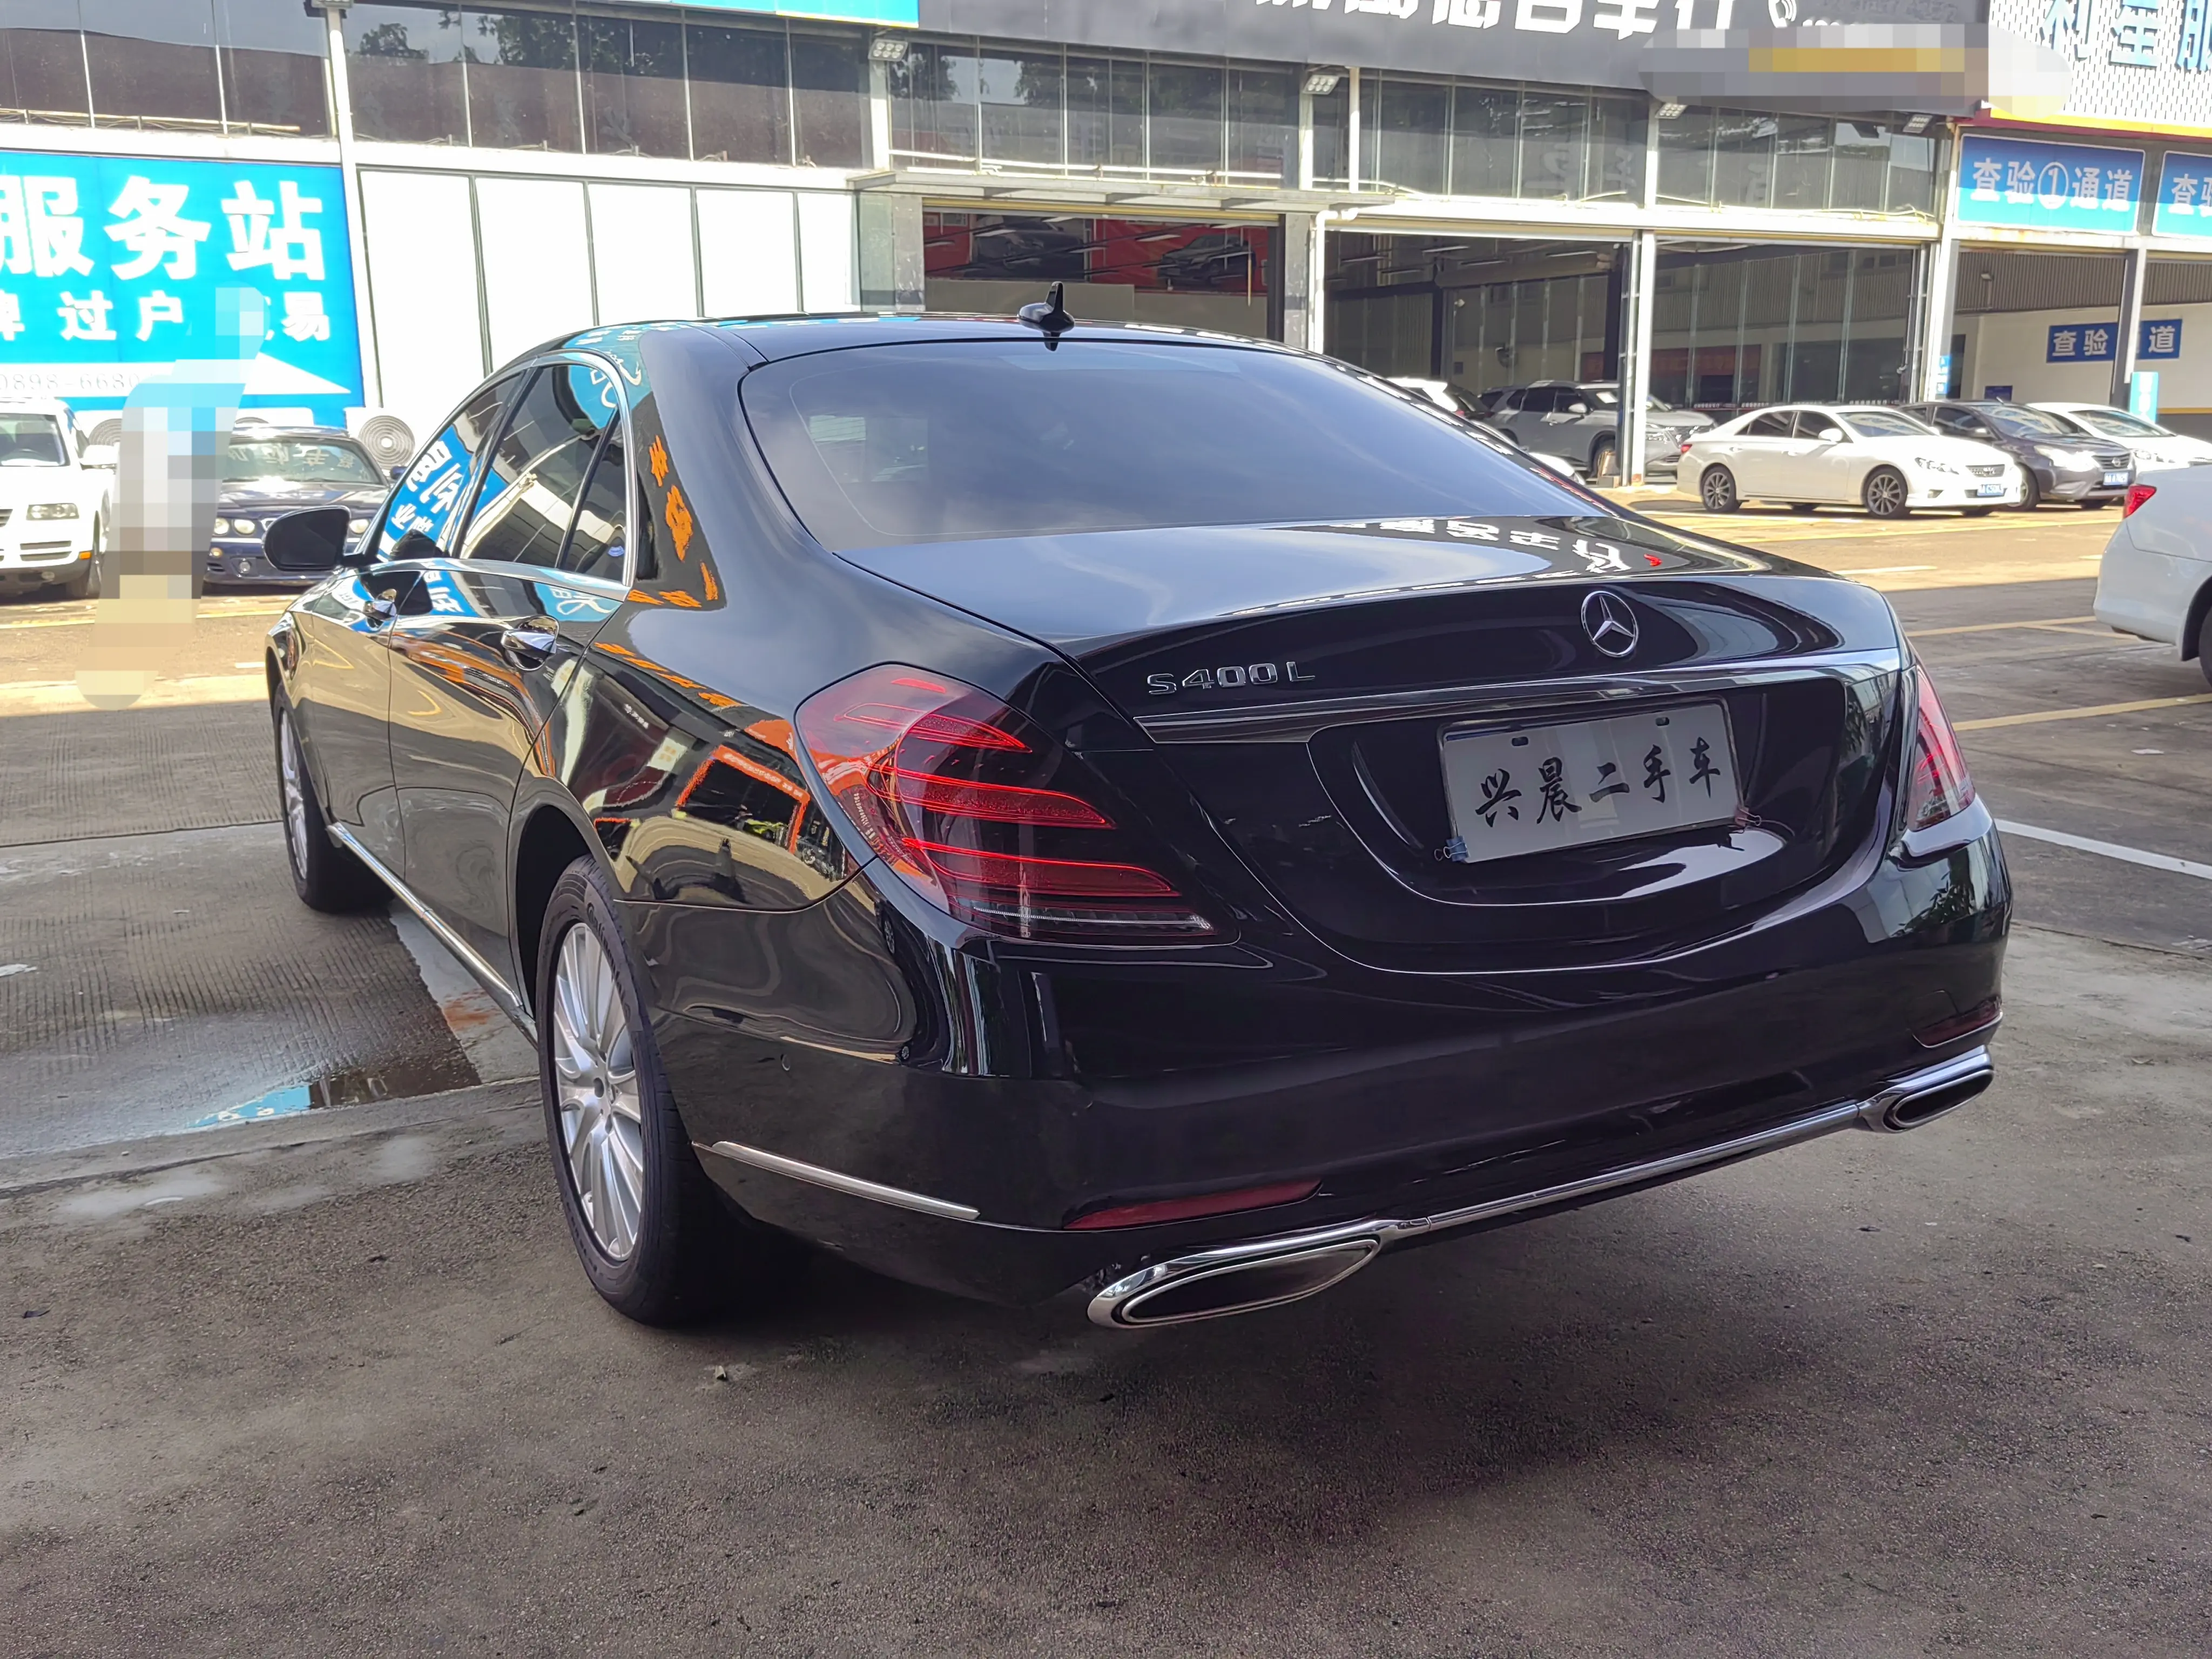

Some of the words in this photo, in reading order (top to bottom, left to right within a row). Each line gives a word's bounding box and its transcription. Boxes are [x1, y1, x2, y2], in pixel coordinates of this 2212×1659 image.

[0, 176, 326, 280] 服务站
[0, 289, 331, 341] 过户易
[2053, 326, 2175, 356] 查验道
[0, 373, 152, 390] 0898-6680
[1475, 737, 1721, 827] 兴晨二手车
